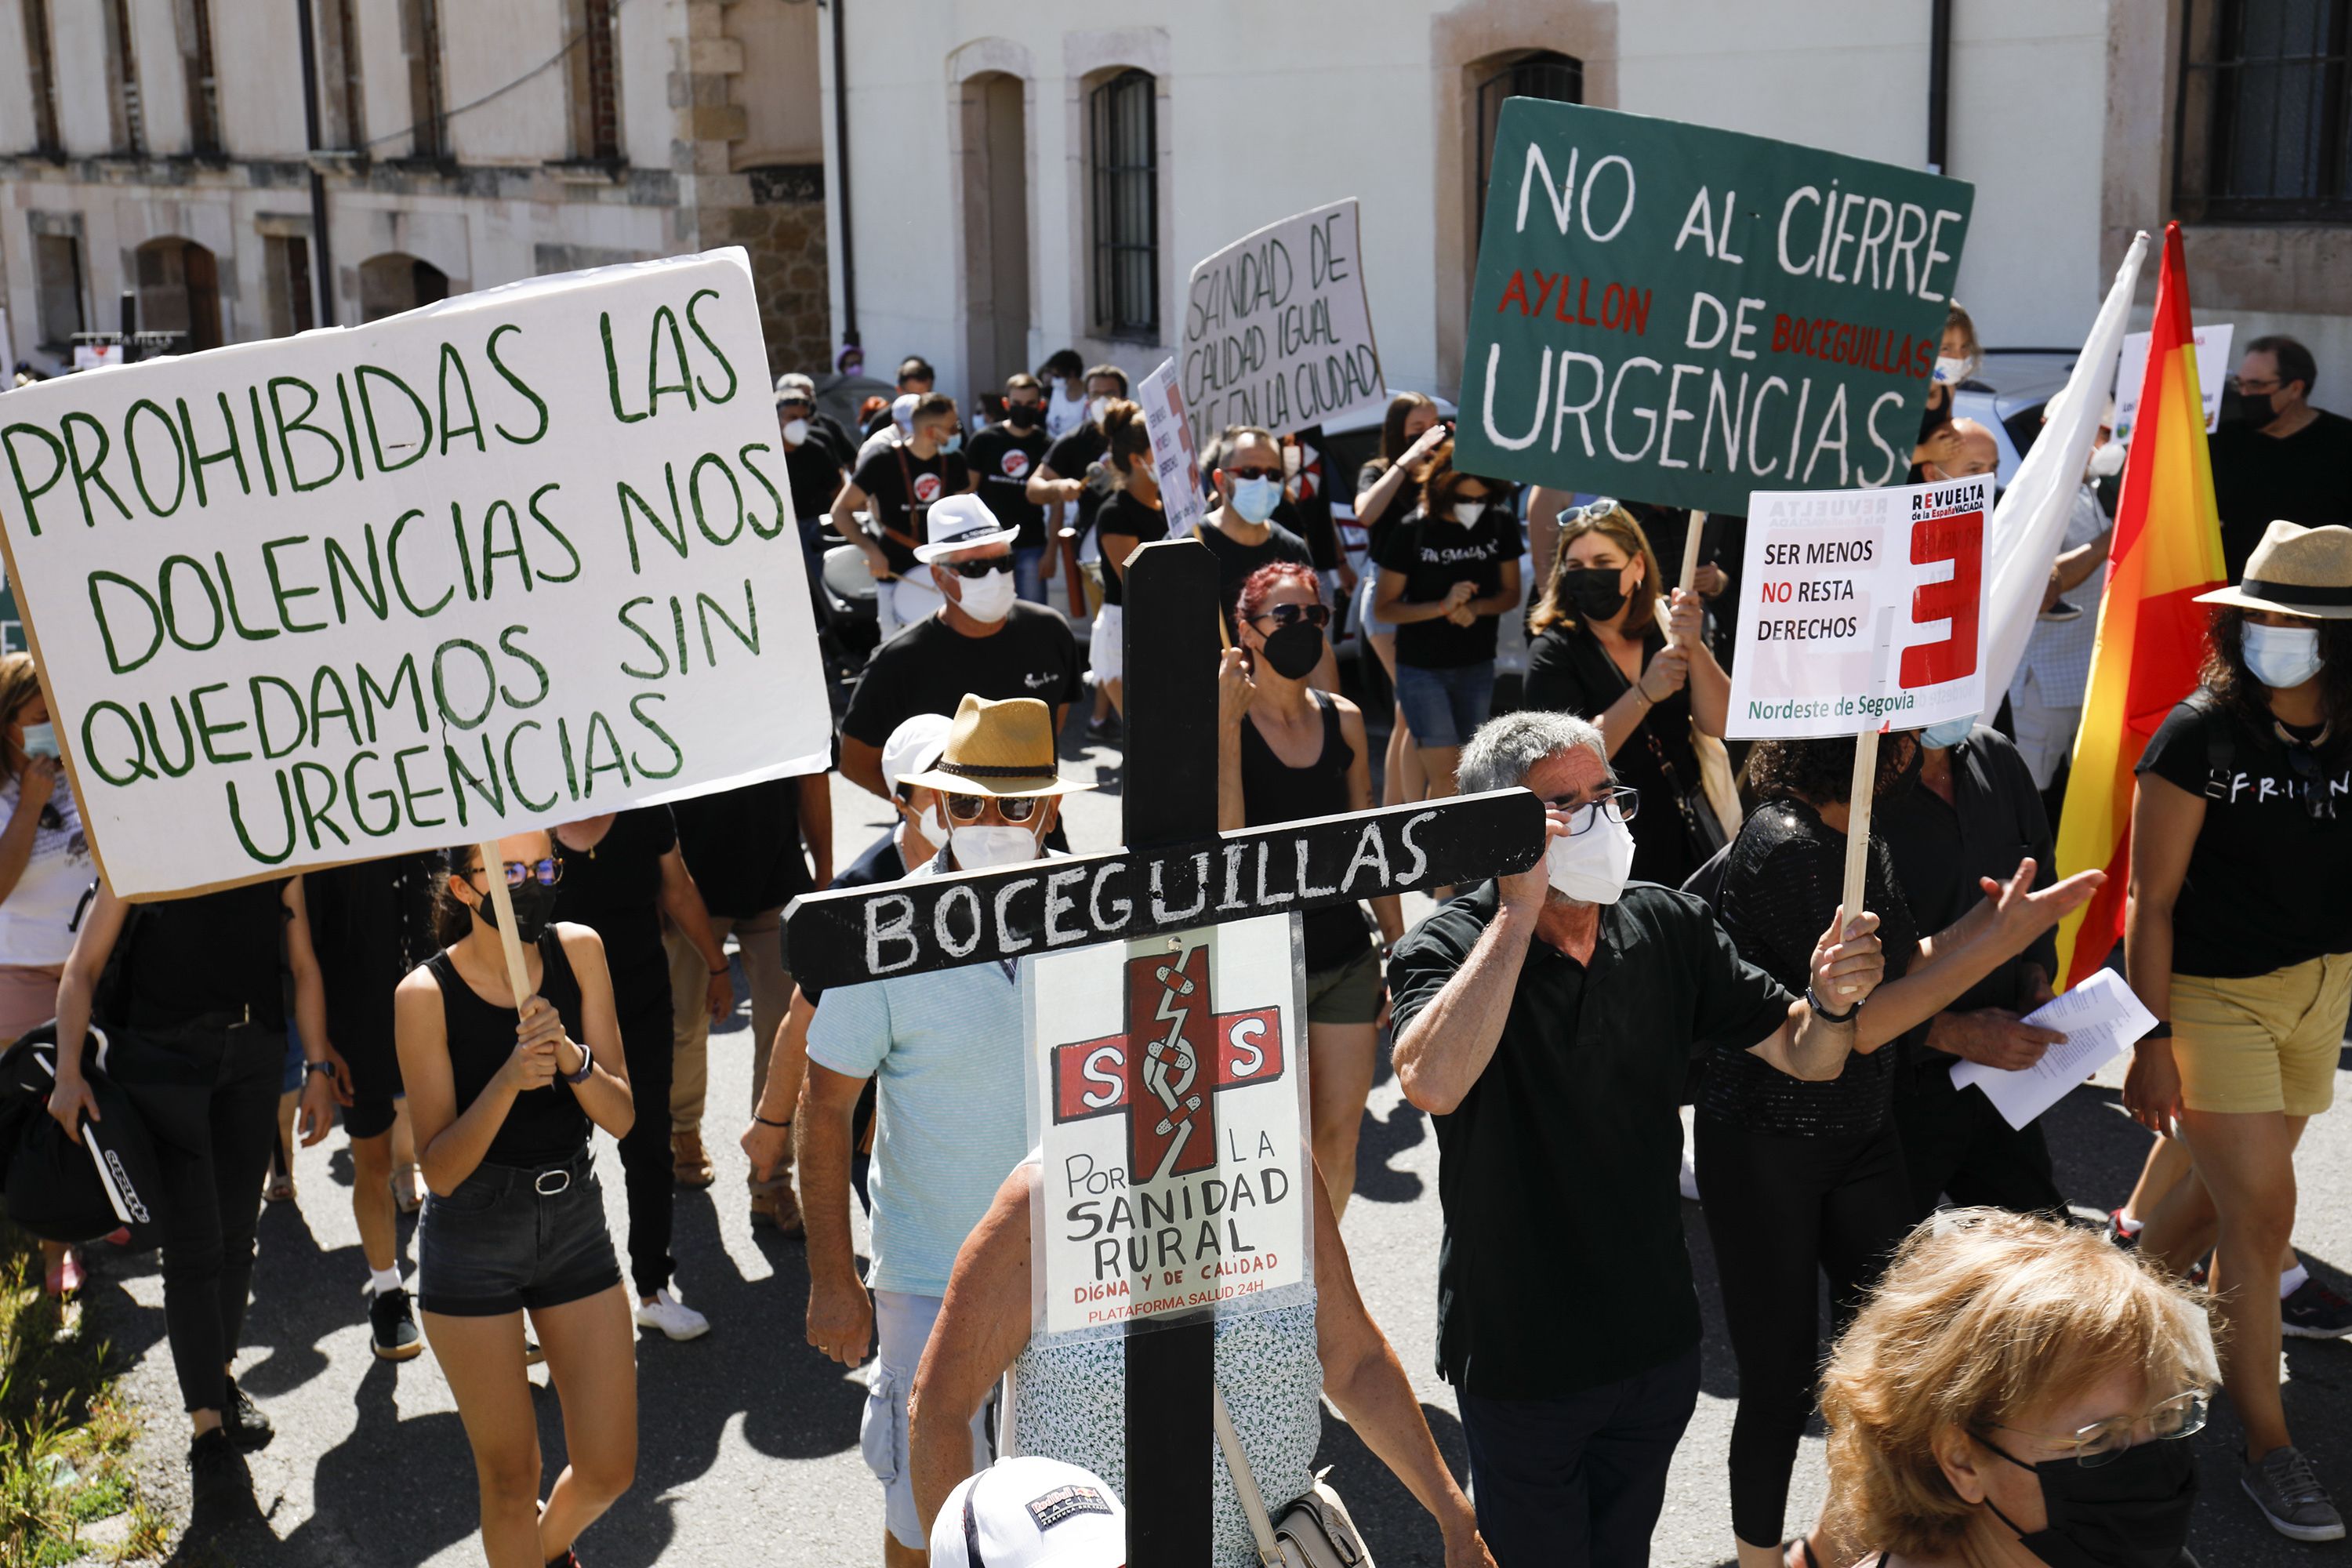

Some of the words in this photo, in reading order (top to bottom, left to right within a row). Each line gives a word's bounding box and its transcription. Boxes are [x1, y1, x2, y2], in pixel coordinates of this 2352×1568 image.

[1515, 141, 1635, 242] NO
[1675, 185, 1744, 264] AL
[1312, 213, 1348, 289] DE
[1497, 269, 1652, 336] AYLLON
[1685, 292, 1766, 360] DE
[1185, 325, 1265, 406] CALIDAD
[1279, 296, 1341, 358] IGUAL
[1771, 314, 1933, 379] BOCEGUILLAS
[2, 325, 550, 536] PROHIBIDAS
[600, 289, 738, 423] LAS
[1265, 372, 1290, 428] LA
[1296, 344, 1377, 419] CIUDAD
[1483, 343, 1904, 488] URGENCIAS
[1912, 484, 1984, 510] REVUELTA
[1912, 511, 1921, 521] de
[1923, 511, 1930, 520] la
[88, 483, 581, 675] DOLENCIAS
[616, 443, 784, 575] NOS
[1764, 543, 1800, 565] SER
[1806, 539, 1873, 564] MENOS
[1762, 581, 1793, 603] NO
[1798, 579, 1854, 602] RESTA
[1757, 616, 1857, 641] DERECHOS
[81, 626, 550, 786] QUEDAMOS
[618, 579, 759, 680] SIN
[1749, 699, 1829, 720] Nordeste
[1834, 696, 1853, 716] de
[1858, 691, 1915, 717] Segovia
[226, 693, 682, 864] URGENCIAS
[865, 811, 1437, 975] BOCEGUILLAS
[1229, 1128, 1275, 1162] LA
[1094, 1218, 1255, 1280] RURAL
[1142, 1273, 1152, 1291] Y
[1163, 1270, 1183, 1285] DE
[1089, 1296, 1185, 1323] PLATAFORMA
[1188, 1286, 1234, 1305] SALUD
[1237, 1279, 1265, 1295] 24H
[1038, 1497, 1104, 1520] RACING
